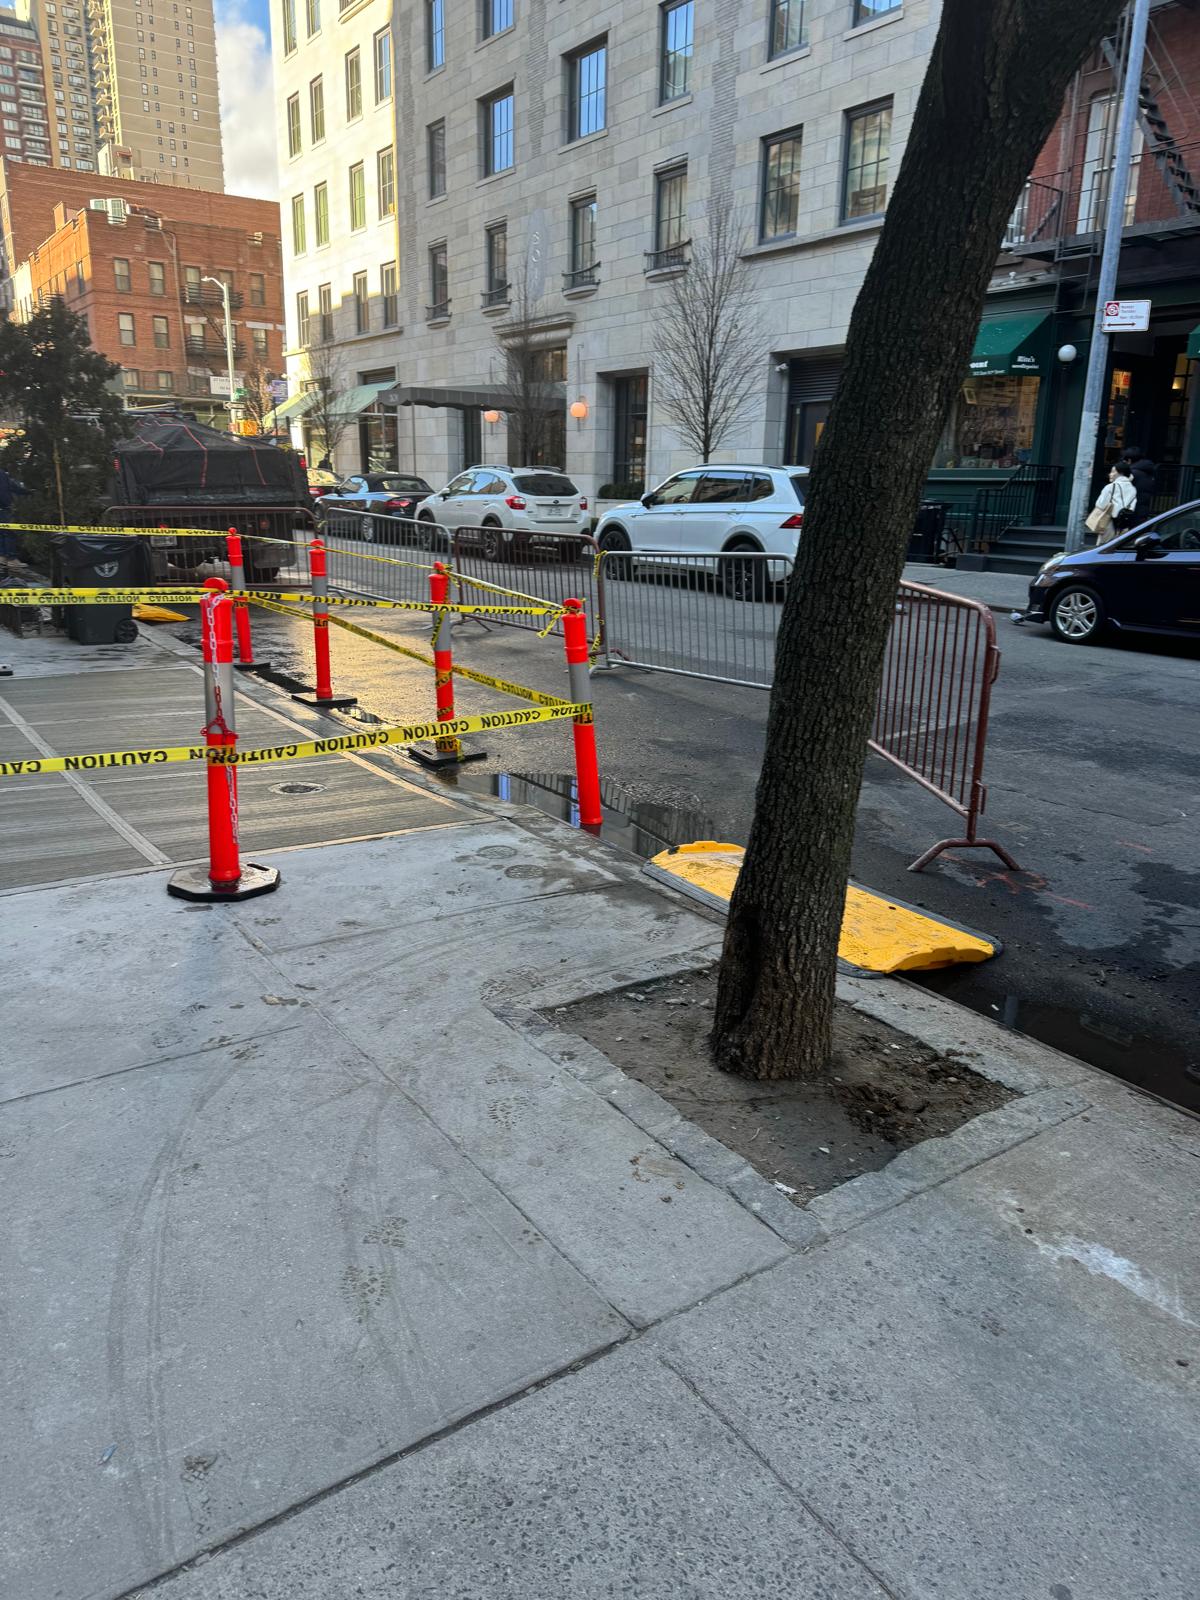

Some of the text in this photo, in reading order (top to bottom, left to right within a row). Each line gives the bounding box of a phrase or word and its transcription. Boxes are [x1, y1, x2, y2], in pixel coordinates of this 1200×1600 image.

[212, 744, 297, 764] CAUTION
[314, 731, 389, 753] CAUTION
[403, 720, 469, 741] CAUTION
[481, 710, 541, 728] CAUTION
[64, 750, 168, 770] CAUTION
